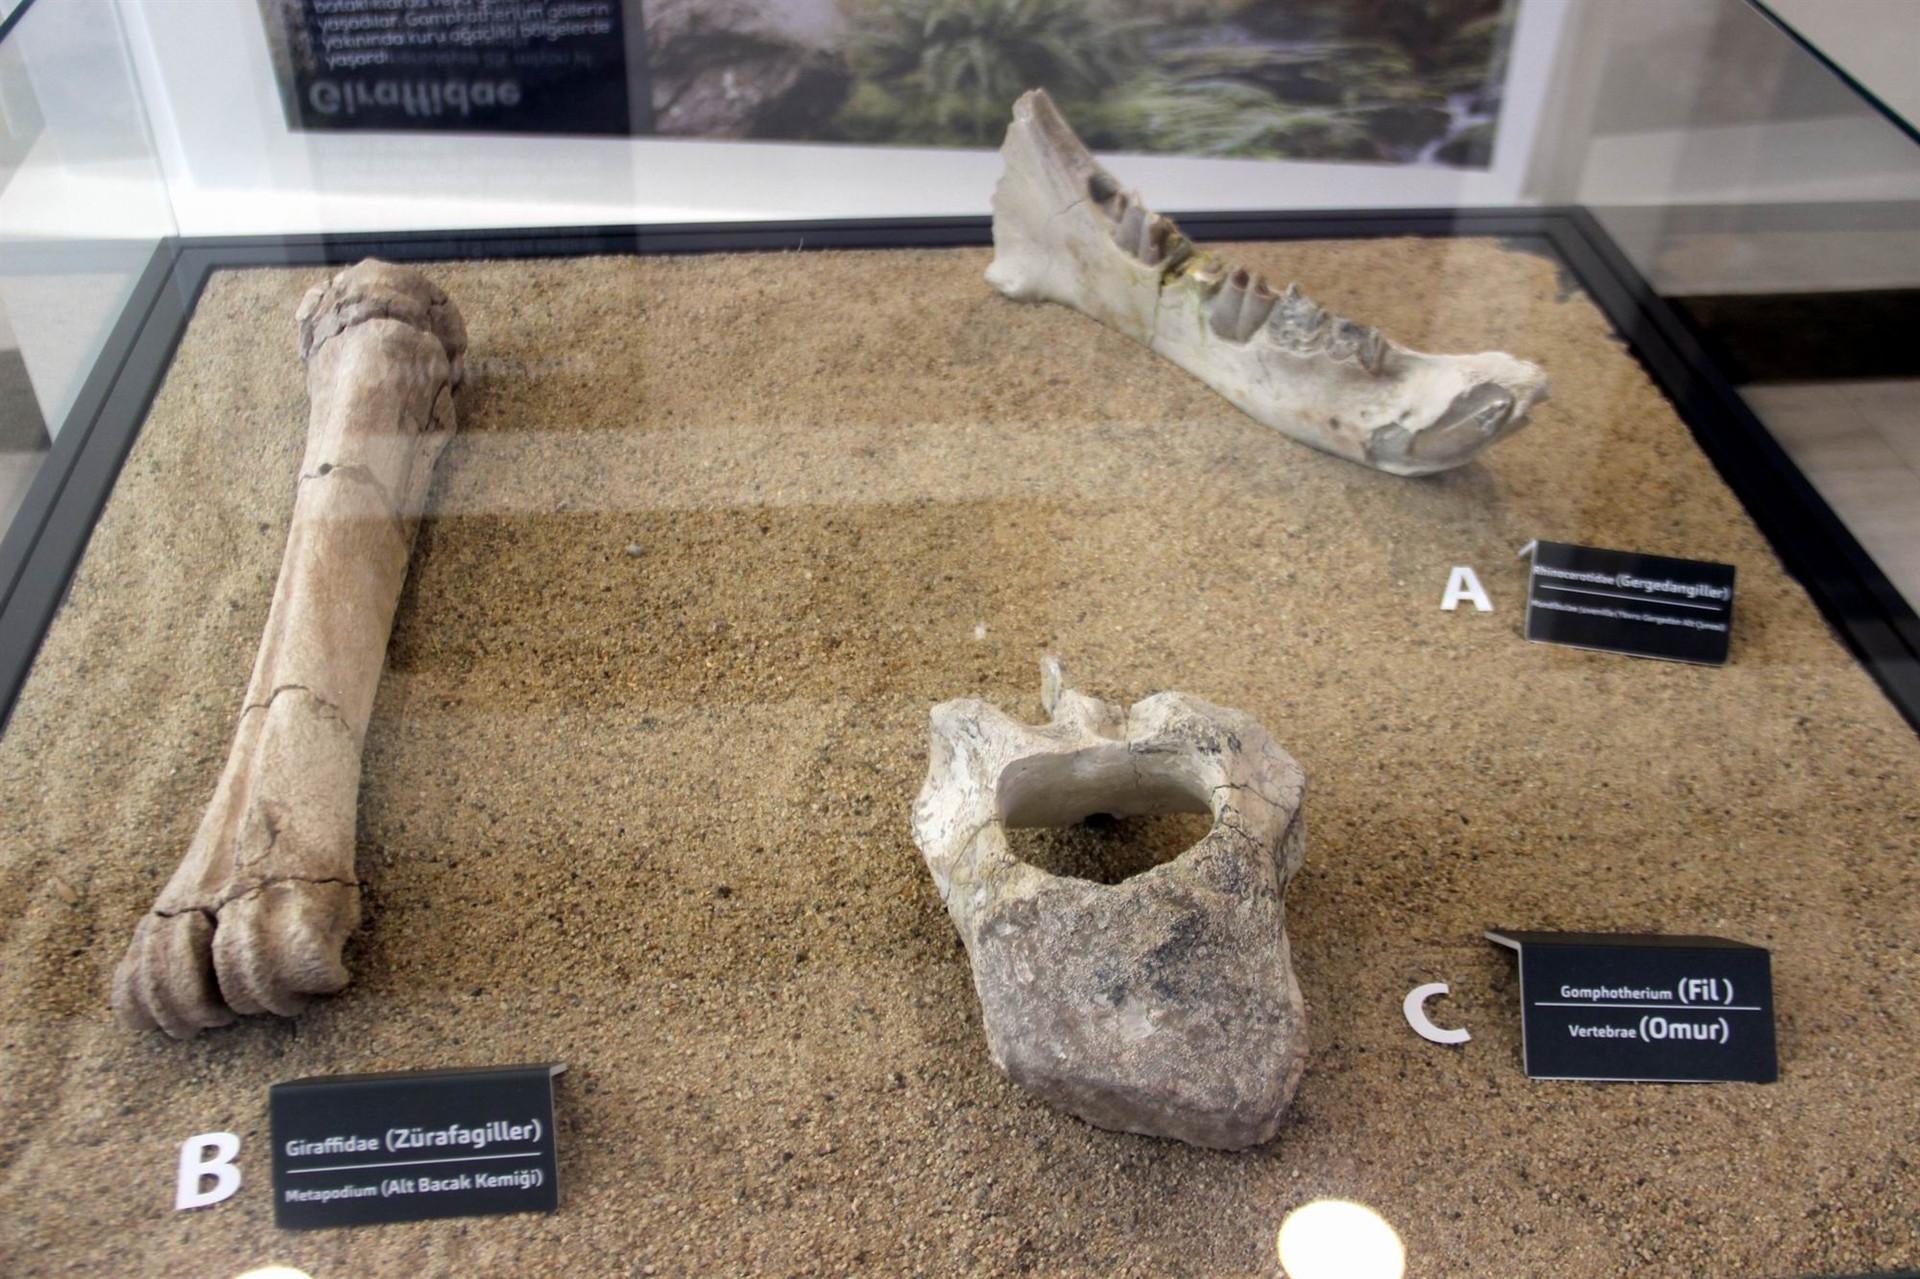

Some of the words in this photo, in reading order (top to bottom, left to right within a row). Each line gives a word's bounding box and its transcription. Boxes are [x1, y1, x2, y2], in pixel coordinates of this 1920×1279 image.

[1440, 565, 1494, 612] A
[1615, 572, 1731, 601] (Gergedangiller)
[1560, 985, 1673, 1001] Gomphotherium
[1403, 982, 1472, 1044] C
[1568, 1024, 1637, 1039] Vertebrae
[1639, 1015, 1730, 1044] (Omur)
[285, 1135, 379, 1157] Giraffidae
[385, 1118, 542, 1152] (Zürafagiller)
[175, 1131, 242, 1211] B
[285, 1183, 378, 1203] Metapodium
[380, 1178, 415, 1198] (Alt
[418, 1174, 471, 1194] Bacak
[474, 1167, 544, 1191] Kemiği)
